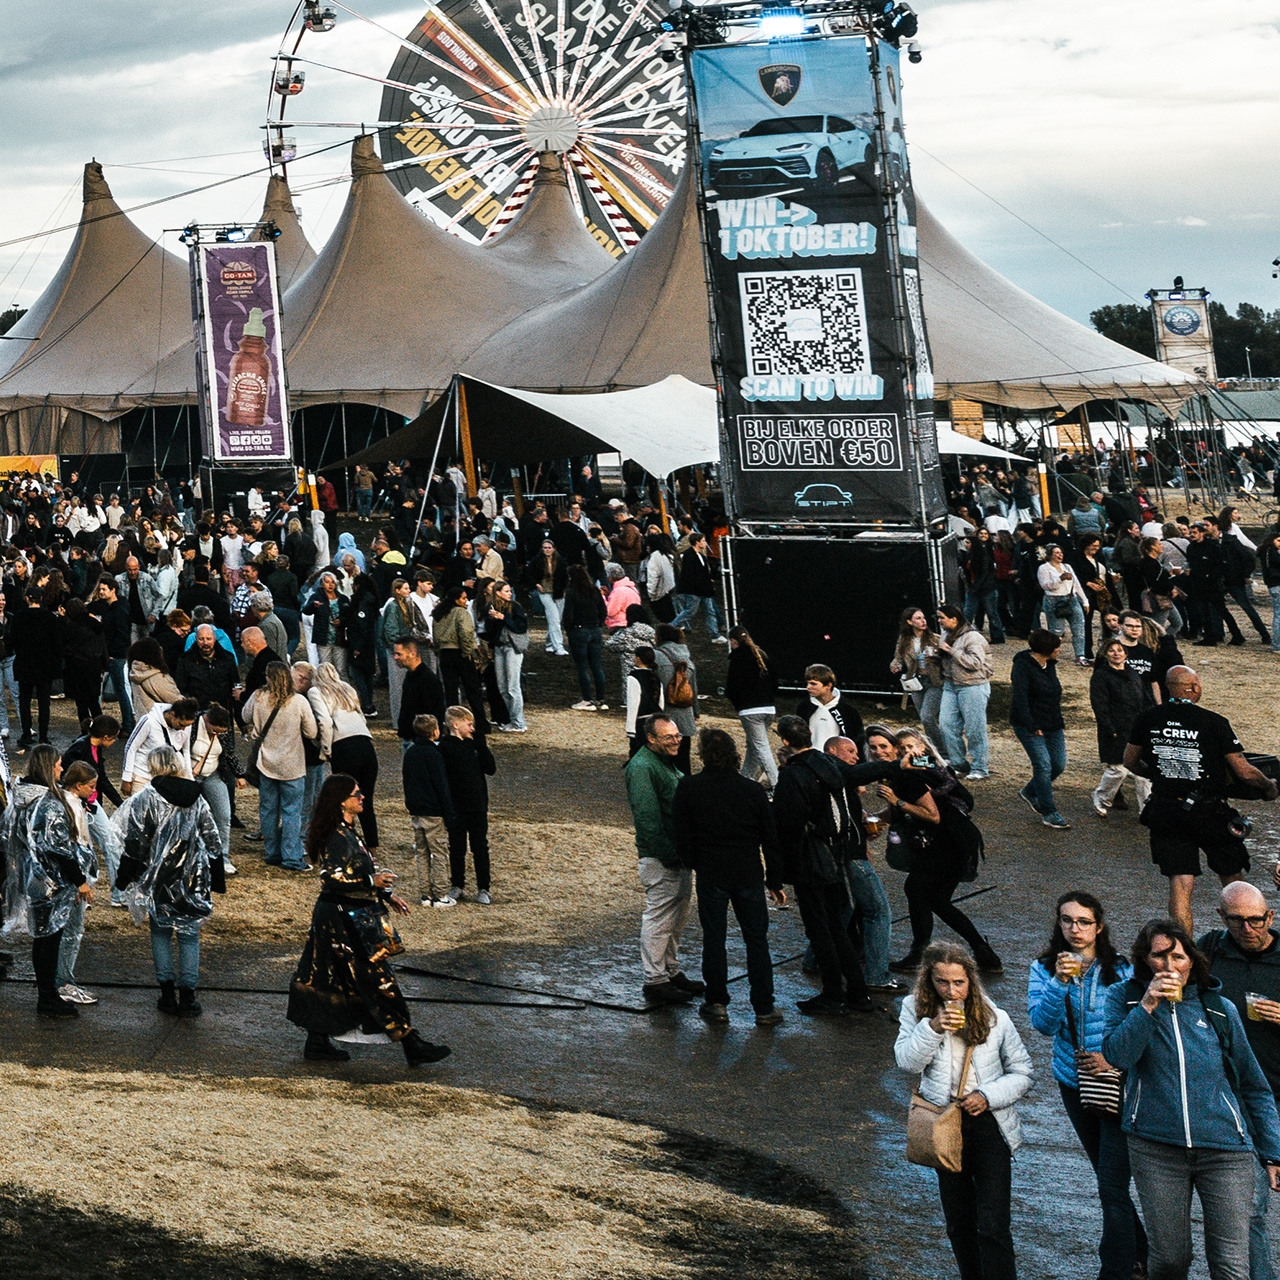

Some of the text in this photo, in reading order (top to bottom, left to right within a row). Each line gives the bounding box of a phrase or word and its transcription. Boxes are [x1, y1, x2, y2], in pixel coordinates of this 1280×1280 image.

[513, 1, 620, 79] SLAAT
[626, 35, 689, 117] VON
[407, 74, 474, 146] ONS?
[394, 110, 503, 229] OLGENDE
[717, 198, 780, 227] WIN
[719, 228, 734, 257] 1
[737, 222, 873, 256] OKTOBER!
[740, 377, 799, 399] SCAN
[803, 377, 833, 399] TO
[834, 375, 880, 398] WIN
[743, 418, 893, 439] BIJ ELKE ORDER
[746, 439, 835, 465] BOVEN
[840, 439, 895, 465] €50
[1162, 728, 1199, 740] CREW
